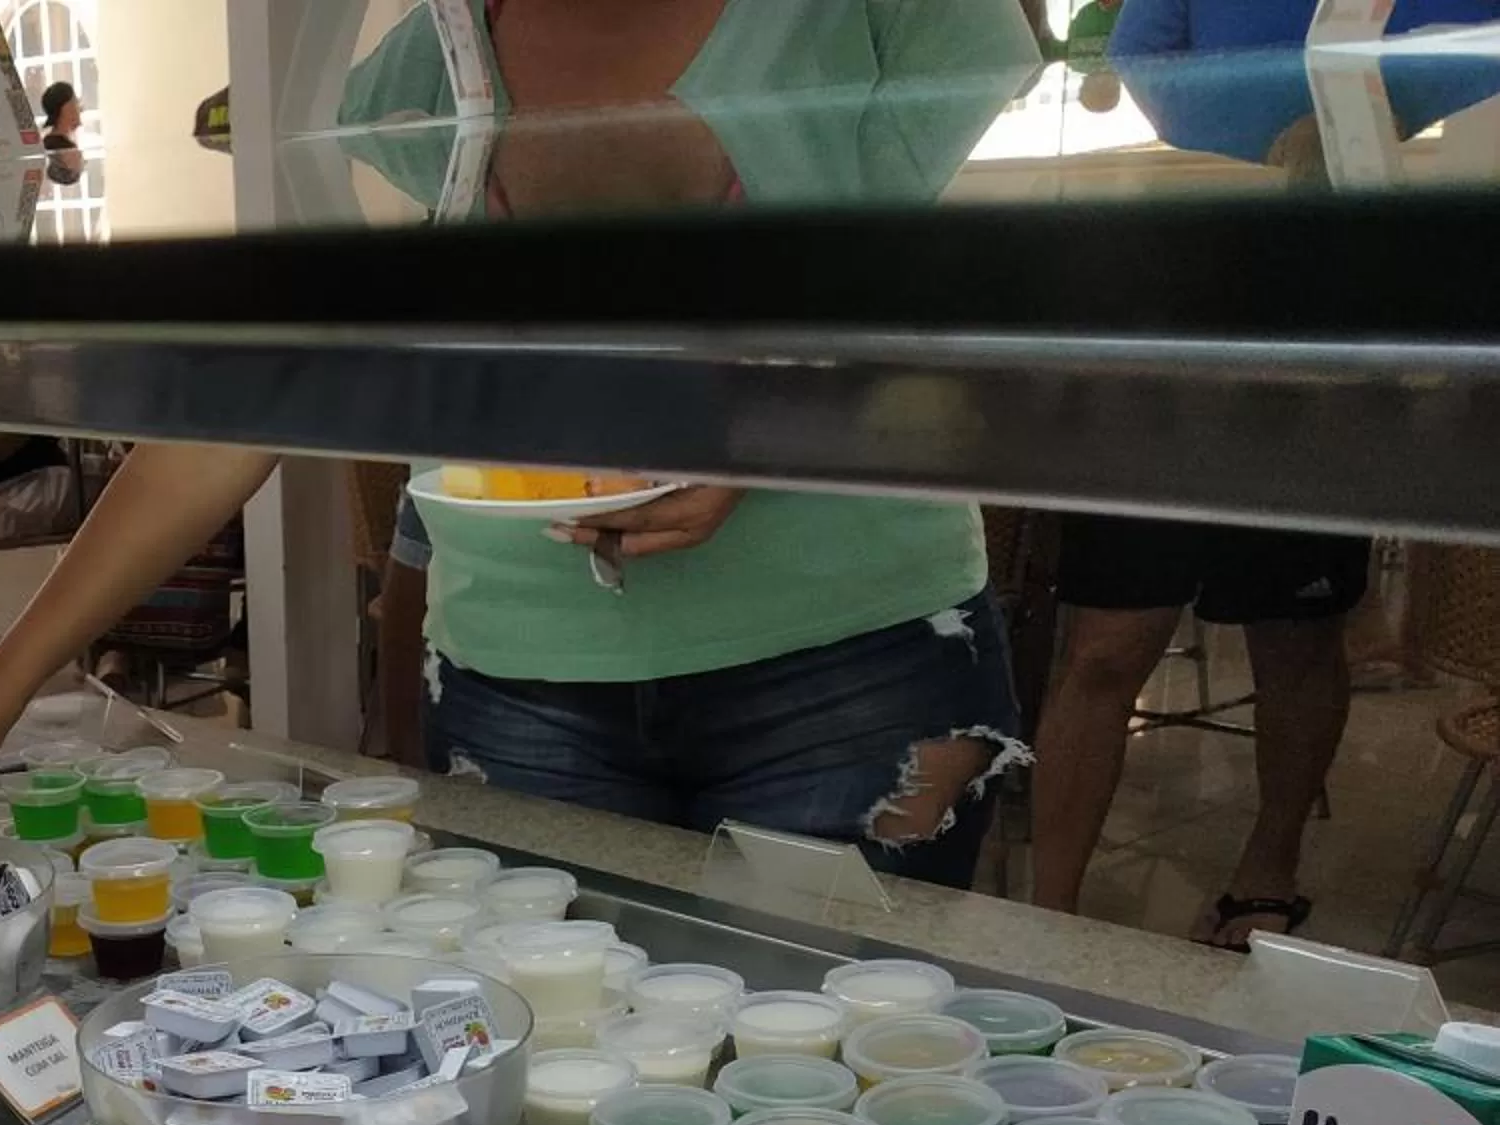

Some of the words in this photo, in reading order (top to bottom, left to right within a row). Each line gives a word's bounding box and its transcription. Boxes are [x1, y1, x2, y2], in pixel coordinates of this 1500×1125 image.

[7, 1033, 60, 1064] MANTEIGA
[24, 1058, 49, 1077] COM
[47, 1048, 68, 1066] SAL
